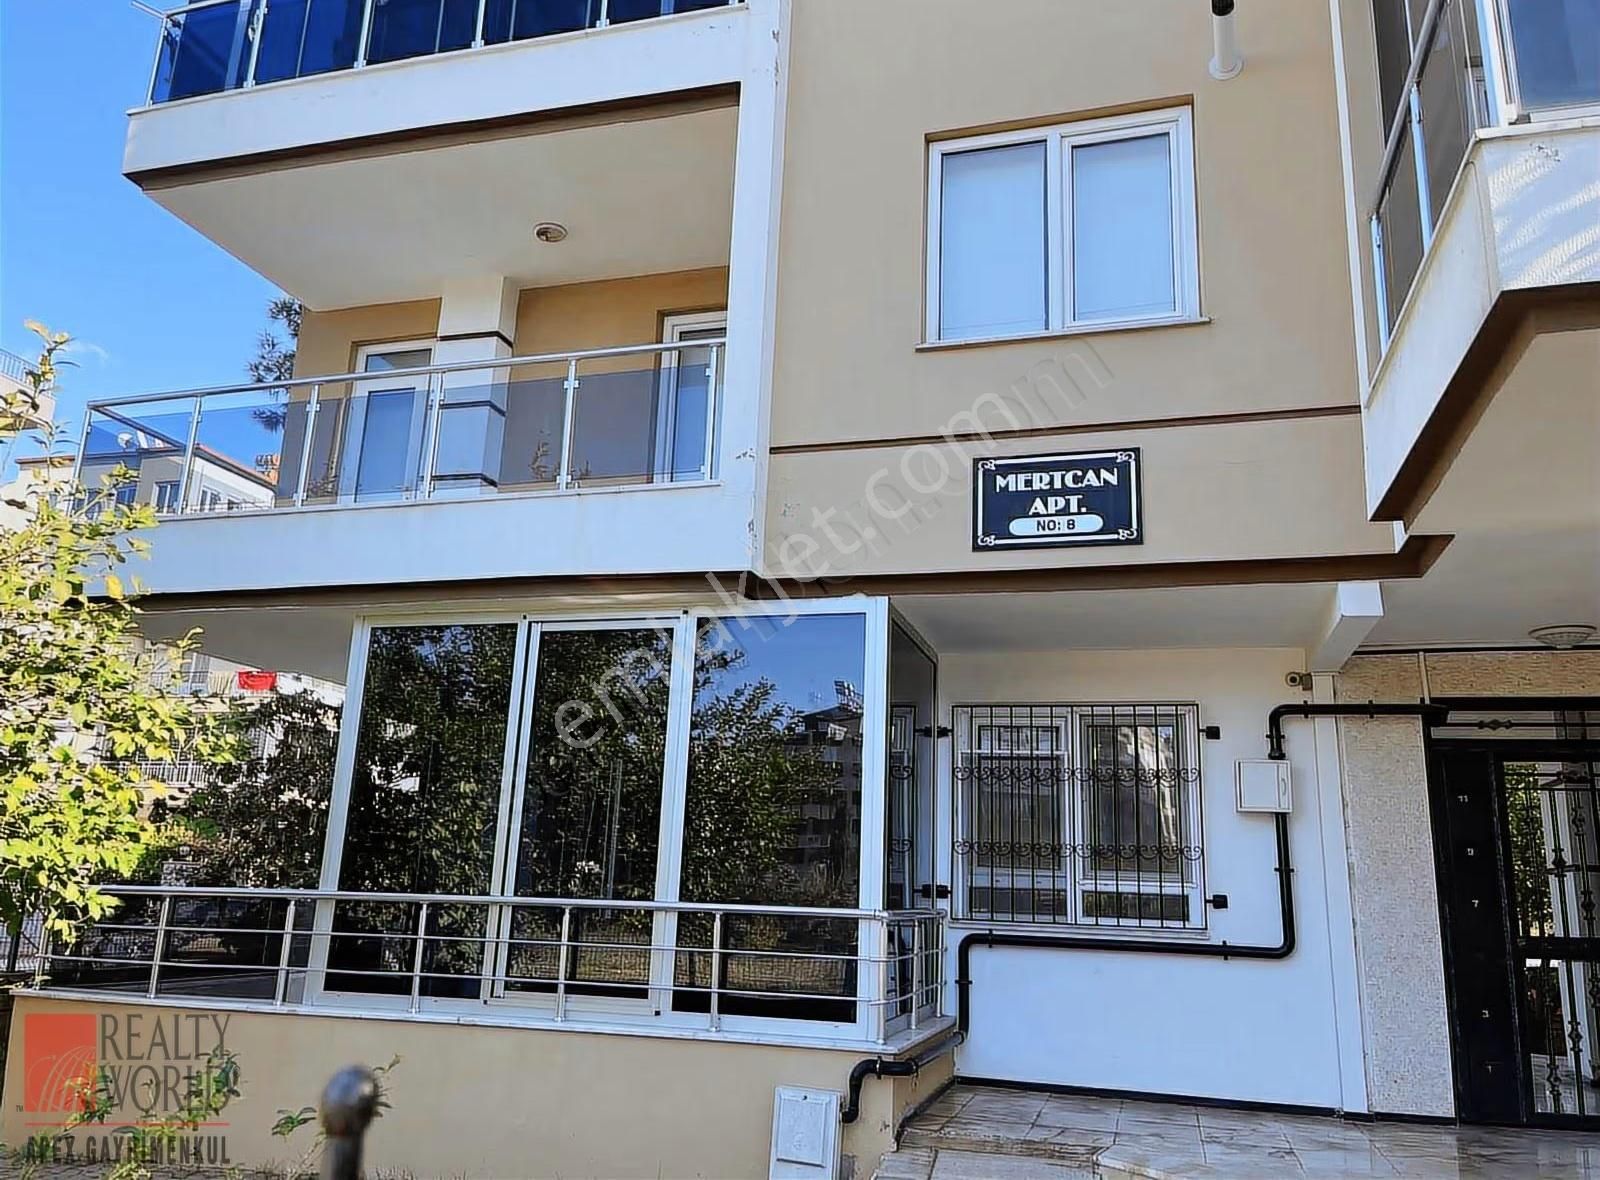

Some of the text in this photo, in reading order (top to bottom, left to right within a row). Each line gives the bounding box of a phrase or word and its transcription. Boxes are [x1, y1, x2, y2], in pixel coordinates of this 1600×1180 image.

[995, 467, 1118, 492] MERTCAN
[1028, 494, 1087, 515] APT.
[1036, 518, 1076, 532] NO: 8
